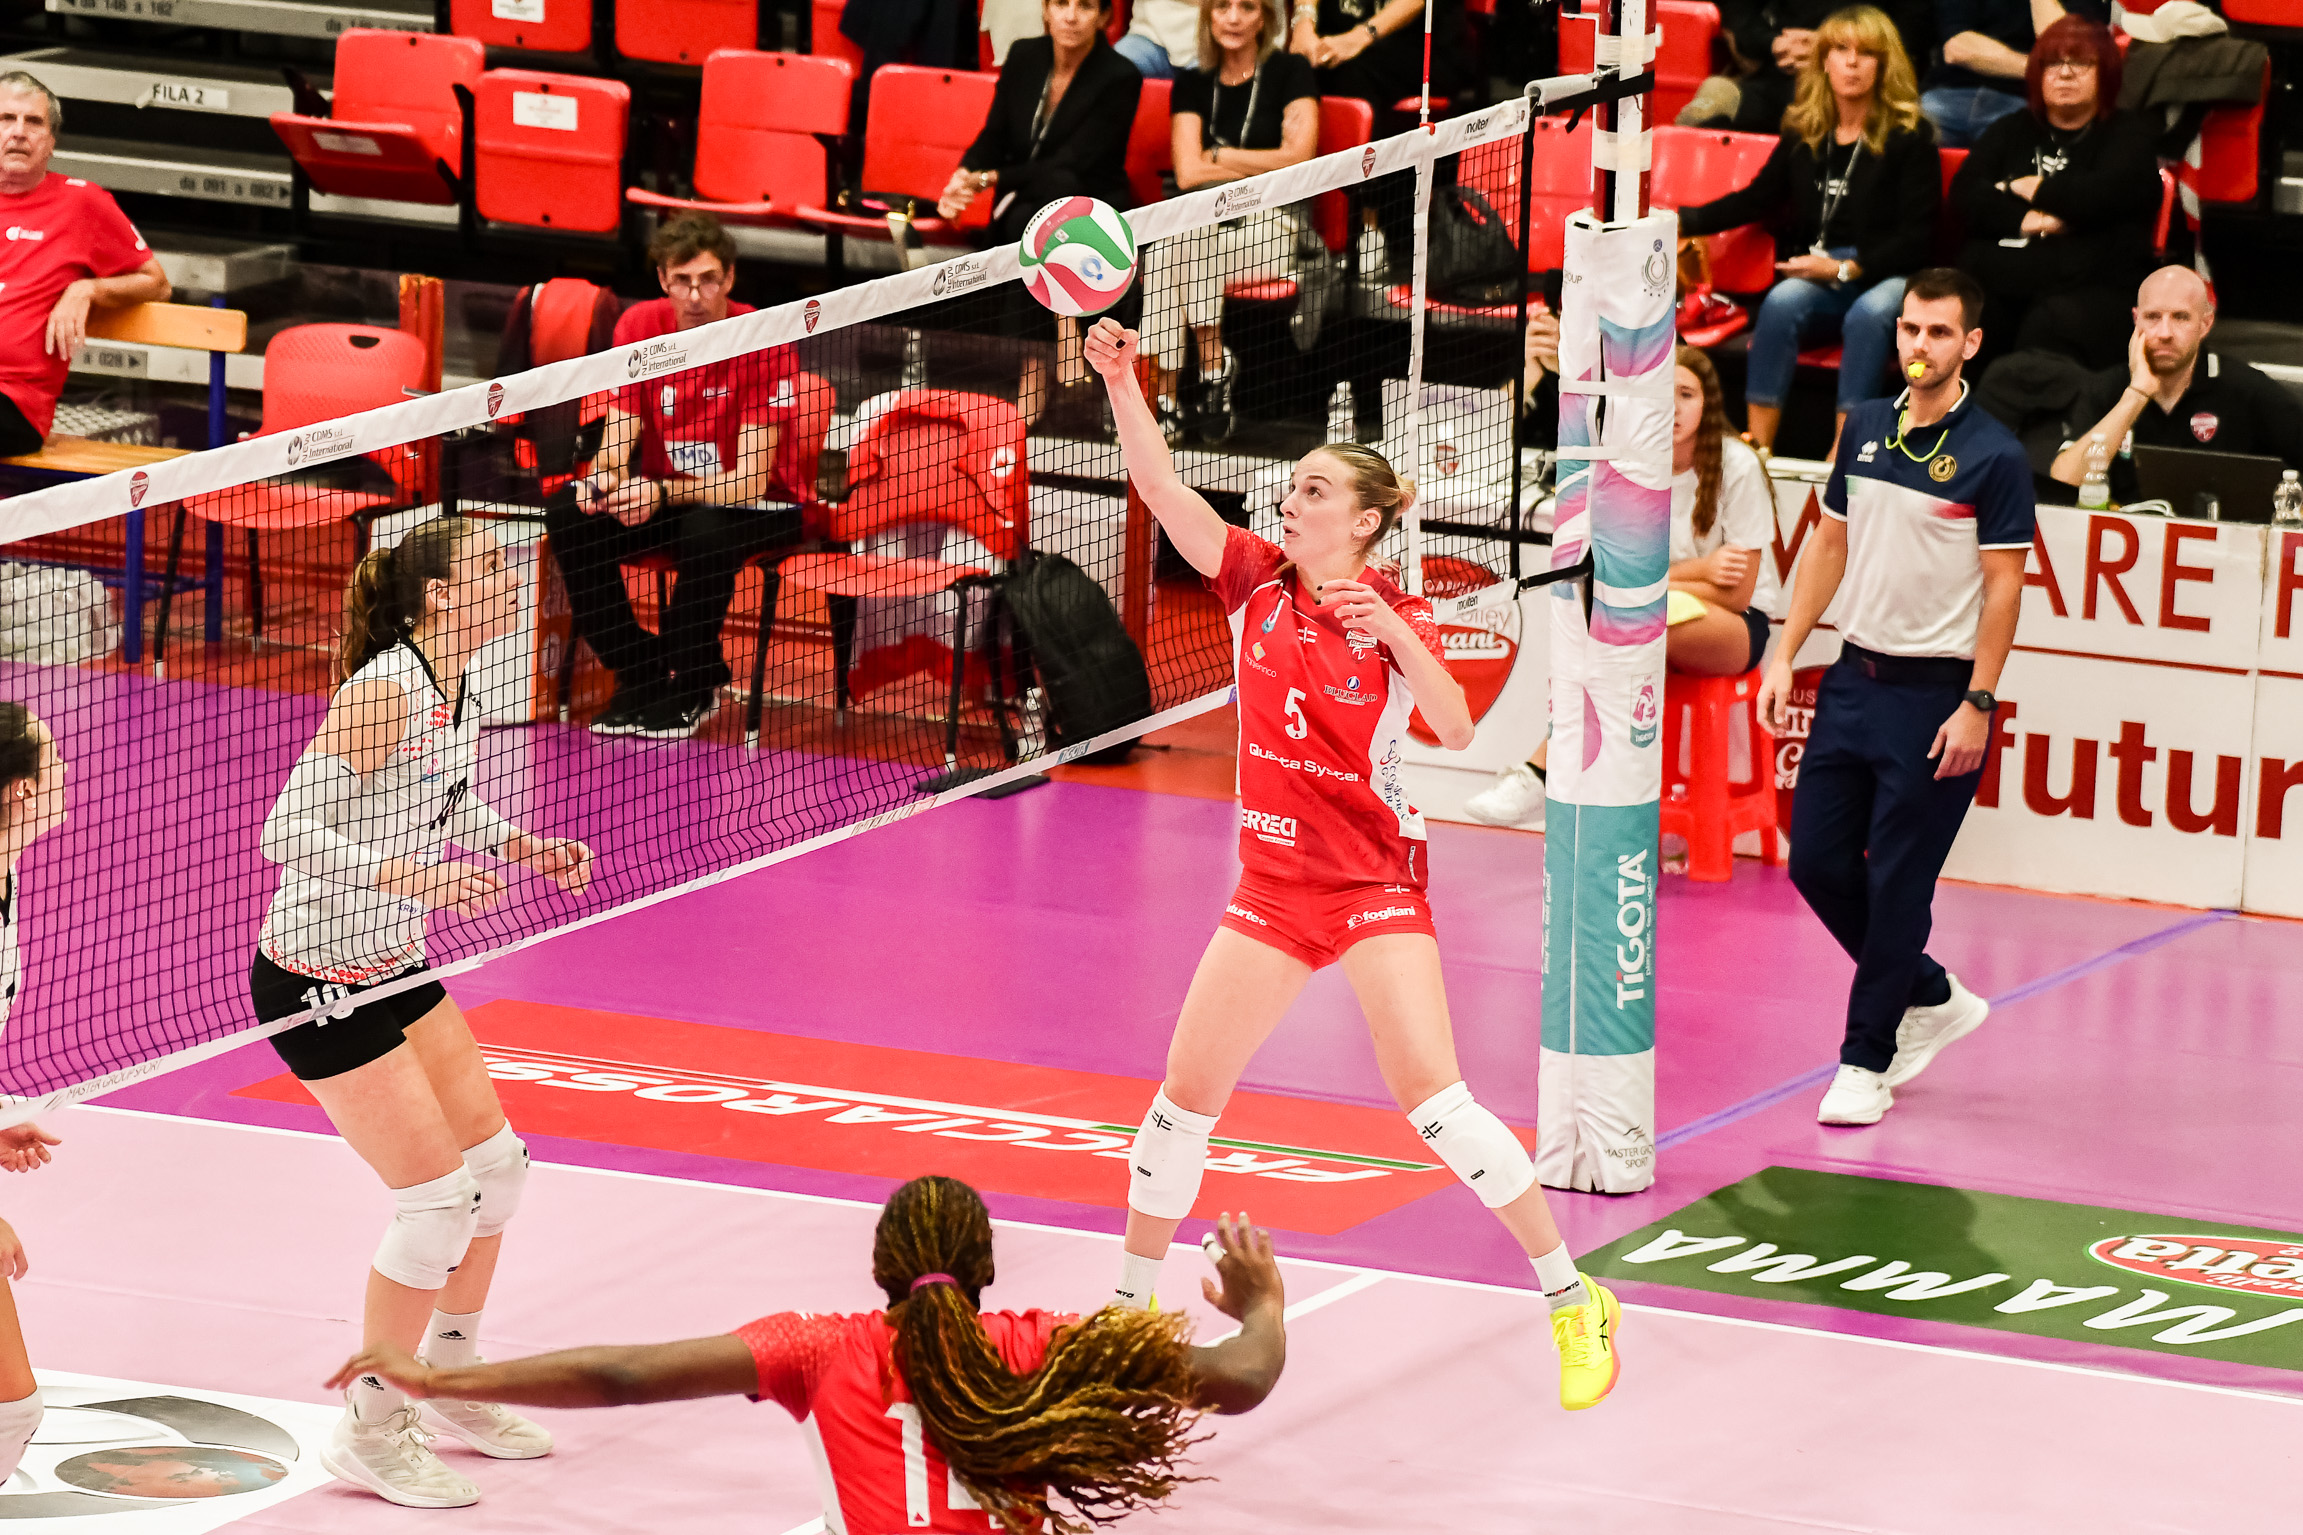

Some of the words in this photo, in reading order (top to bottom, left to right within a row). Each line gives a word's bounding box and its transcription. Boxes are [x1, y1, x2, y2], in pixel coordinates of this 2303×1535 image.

[152, 83, 189, 102] FILA
[194, 89, 204, 105] 2
[952, 270, 987, 289] International
[648, 352, 687, 371] International
[311, 428, 334, 444] CDMS
[308, 438, 353, 459] International
[1283, 686, 1308, 740] 5
[1362, 905, 1416, 922] fogliani
[1603, 1147, 1639, 1159] MASTER
[1624, 1156, 1648, 1169] SPORT
